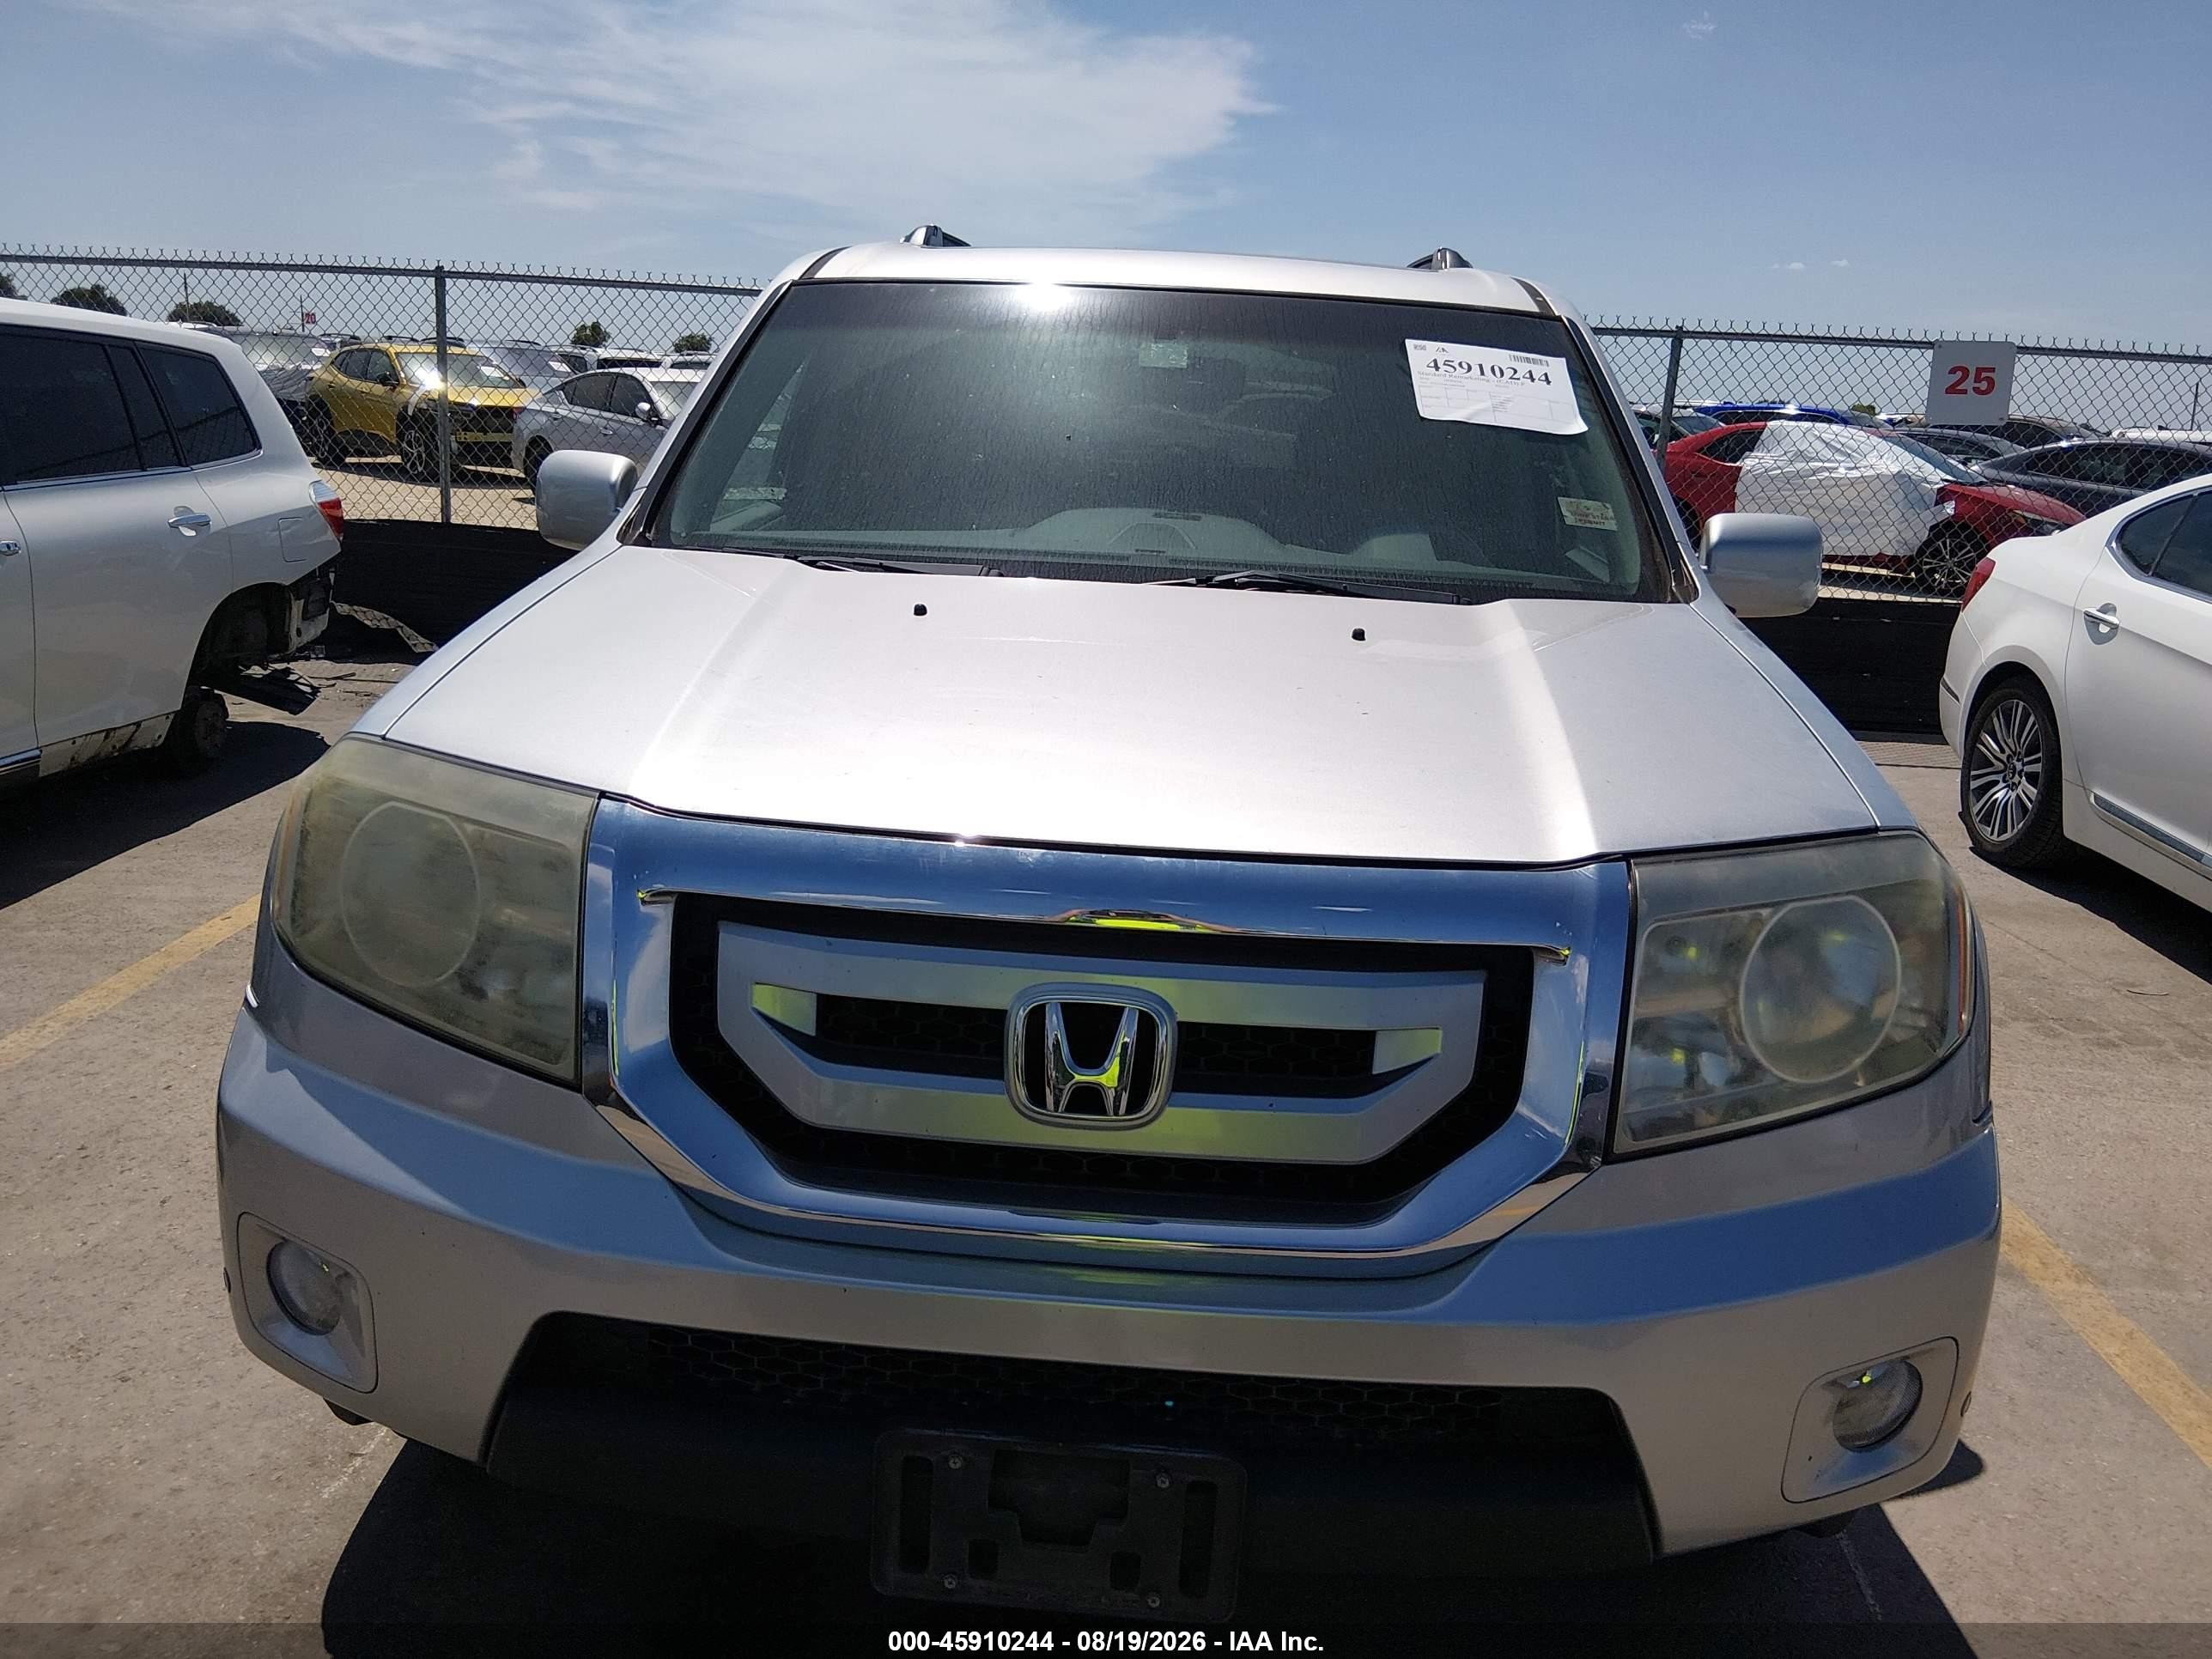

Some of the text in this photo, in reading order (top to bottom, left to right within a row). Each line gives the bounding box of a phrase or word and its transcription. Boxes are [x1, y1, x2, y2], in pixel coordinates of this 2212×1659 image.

[305, 313, 316, 324] 20
[1425, 357, 1553, 386] 45910244
[1944, 365, 1996, 396] 25
